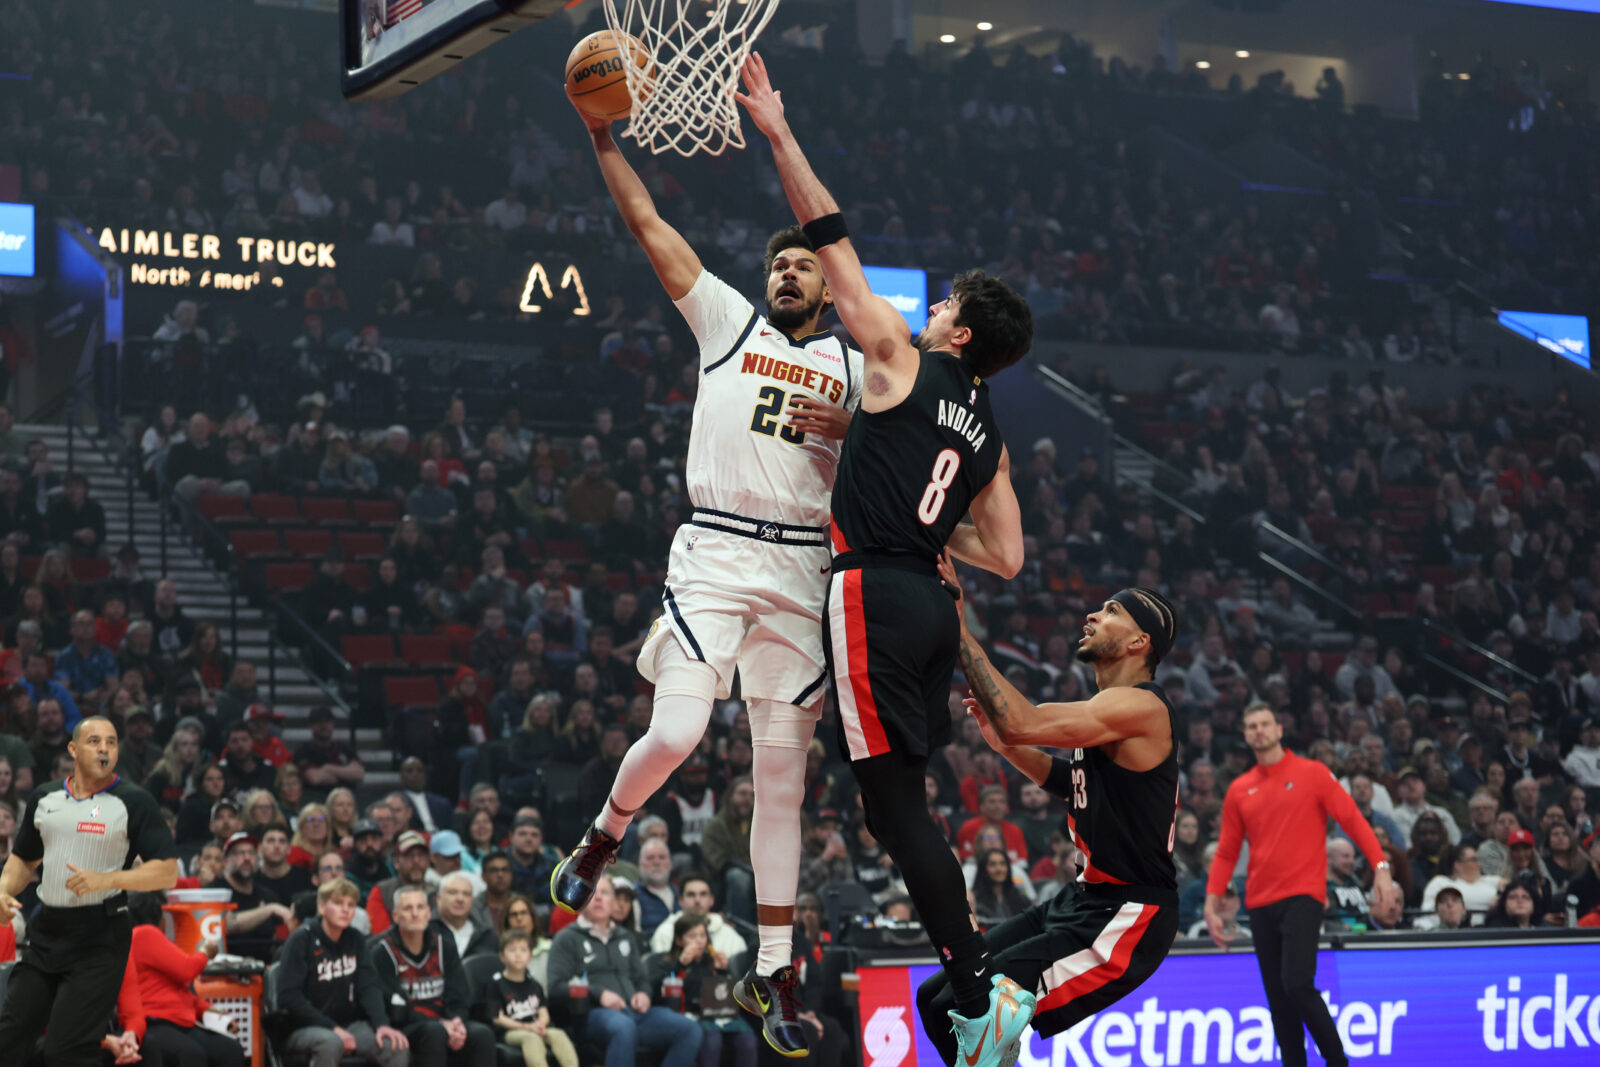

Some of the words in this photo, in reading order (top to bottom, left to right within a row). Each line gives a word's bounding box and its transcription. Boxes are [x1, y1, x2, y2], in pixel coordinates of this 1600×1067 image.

[87, 226, 221, 260] AIMLER
[236, 236, 336, 268] TRUCK
[131, 263, 191, 287] North
[741, 352, 844, 404] NUGGETS
[812, 348, 842, 363] ibotta
[749, 385, 815, 446] 23
[937, 399, 987, 454] AVDIJA
[917, 447, 962, 526] 8
[201, 914, 223, 941] G
